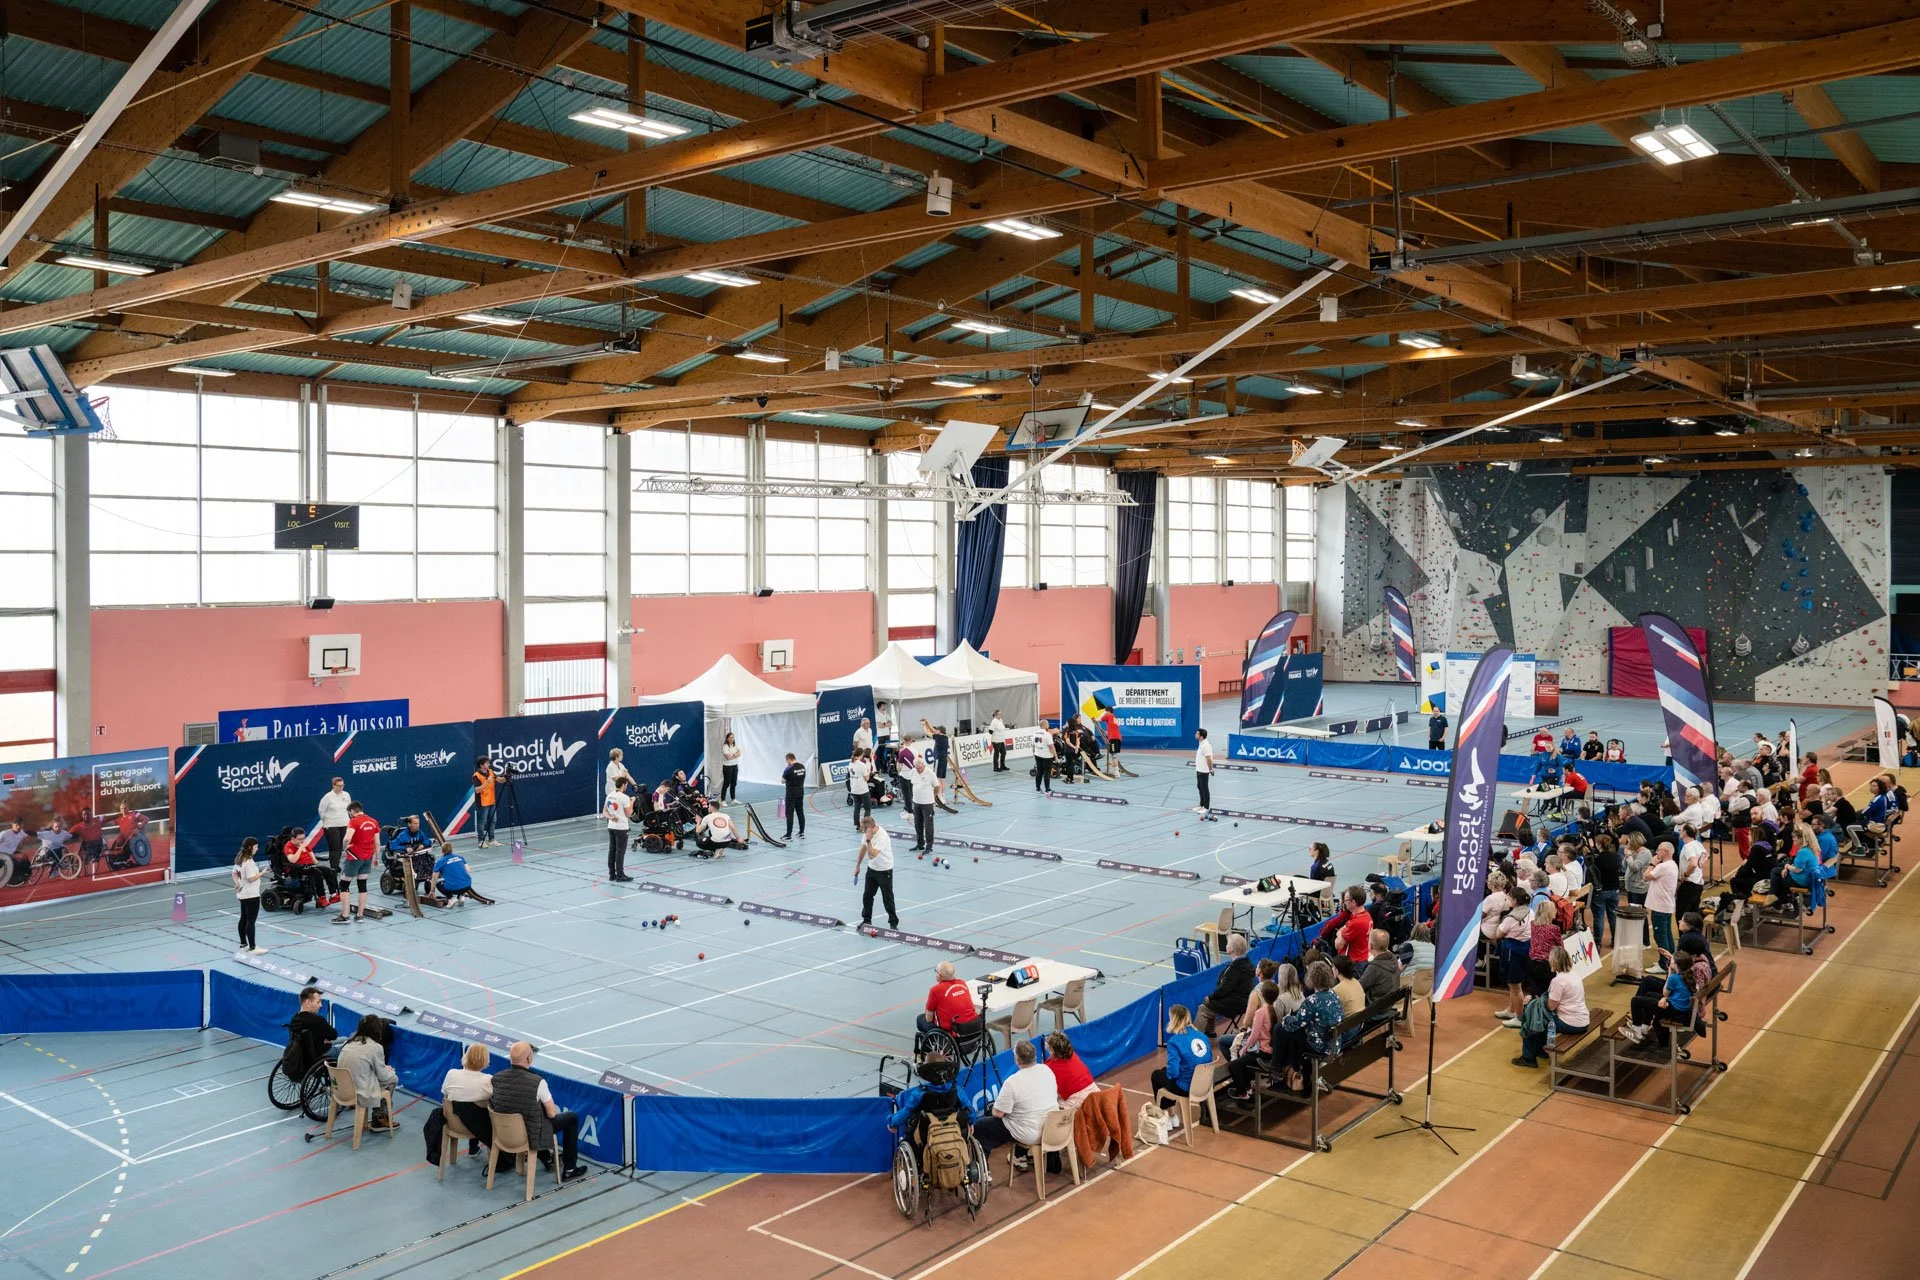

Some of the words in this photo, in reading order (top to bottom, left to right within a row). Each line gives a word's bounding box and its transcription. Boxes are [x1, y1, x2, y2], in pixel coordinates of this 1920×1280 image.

[1125, 688, 1169, 696] DÉPARTEMENT
[1119, 697, 1125, 705] DE
[819, 714, 840, 724] FRANCE
[626, 722, 657, 735] Handi
[1341, 725, 1346, 733] 2
[628, 732, 657, 747] Sport
[960, 740, 981, 751] Handi
[487, 738, 544, 760] Handi
[962, 749, 982, 762] Sport
[1249, 746, 1297, 760] JOOLA
[352, 756, 389, 765] CHAMPIONNAT
[414, 751, 439, 761] Handi
[218, 760, 265, 779] Handi
[352, 760, 398, 774] FRANCE
[416, 758, 438, 769] Sport
[100, 770, 113, 779] SG
[114, 766, 153, 778] engagée
[511, 772, 540, 780] FÉDÉRATION
[540, 769, 565, 777] FRANÇAISE
[100, 777, 131, 788] auprès
[100, 786, 114, 796] du
[114, 782, 161, 795] handisport
[221, 773, 264, 792] Sport
[1452, 813, 1471, 895] Handi
[1462, 816, 1482, 890] Sport
[176, 895, 184, 905] 3
